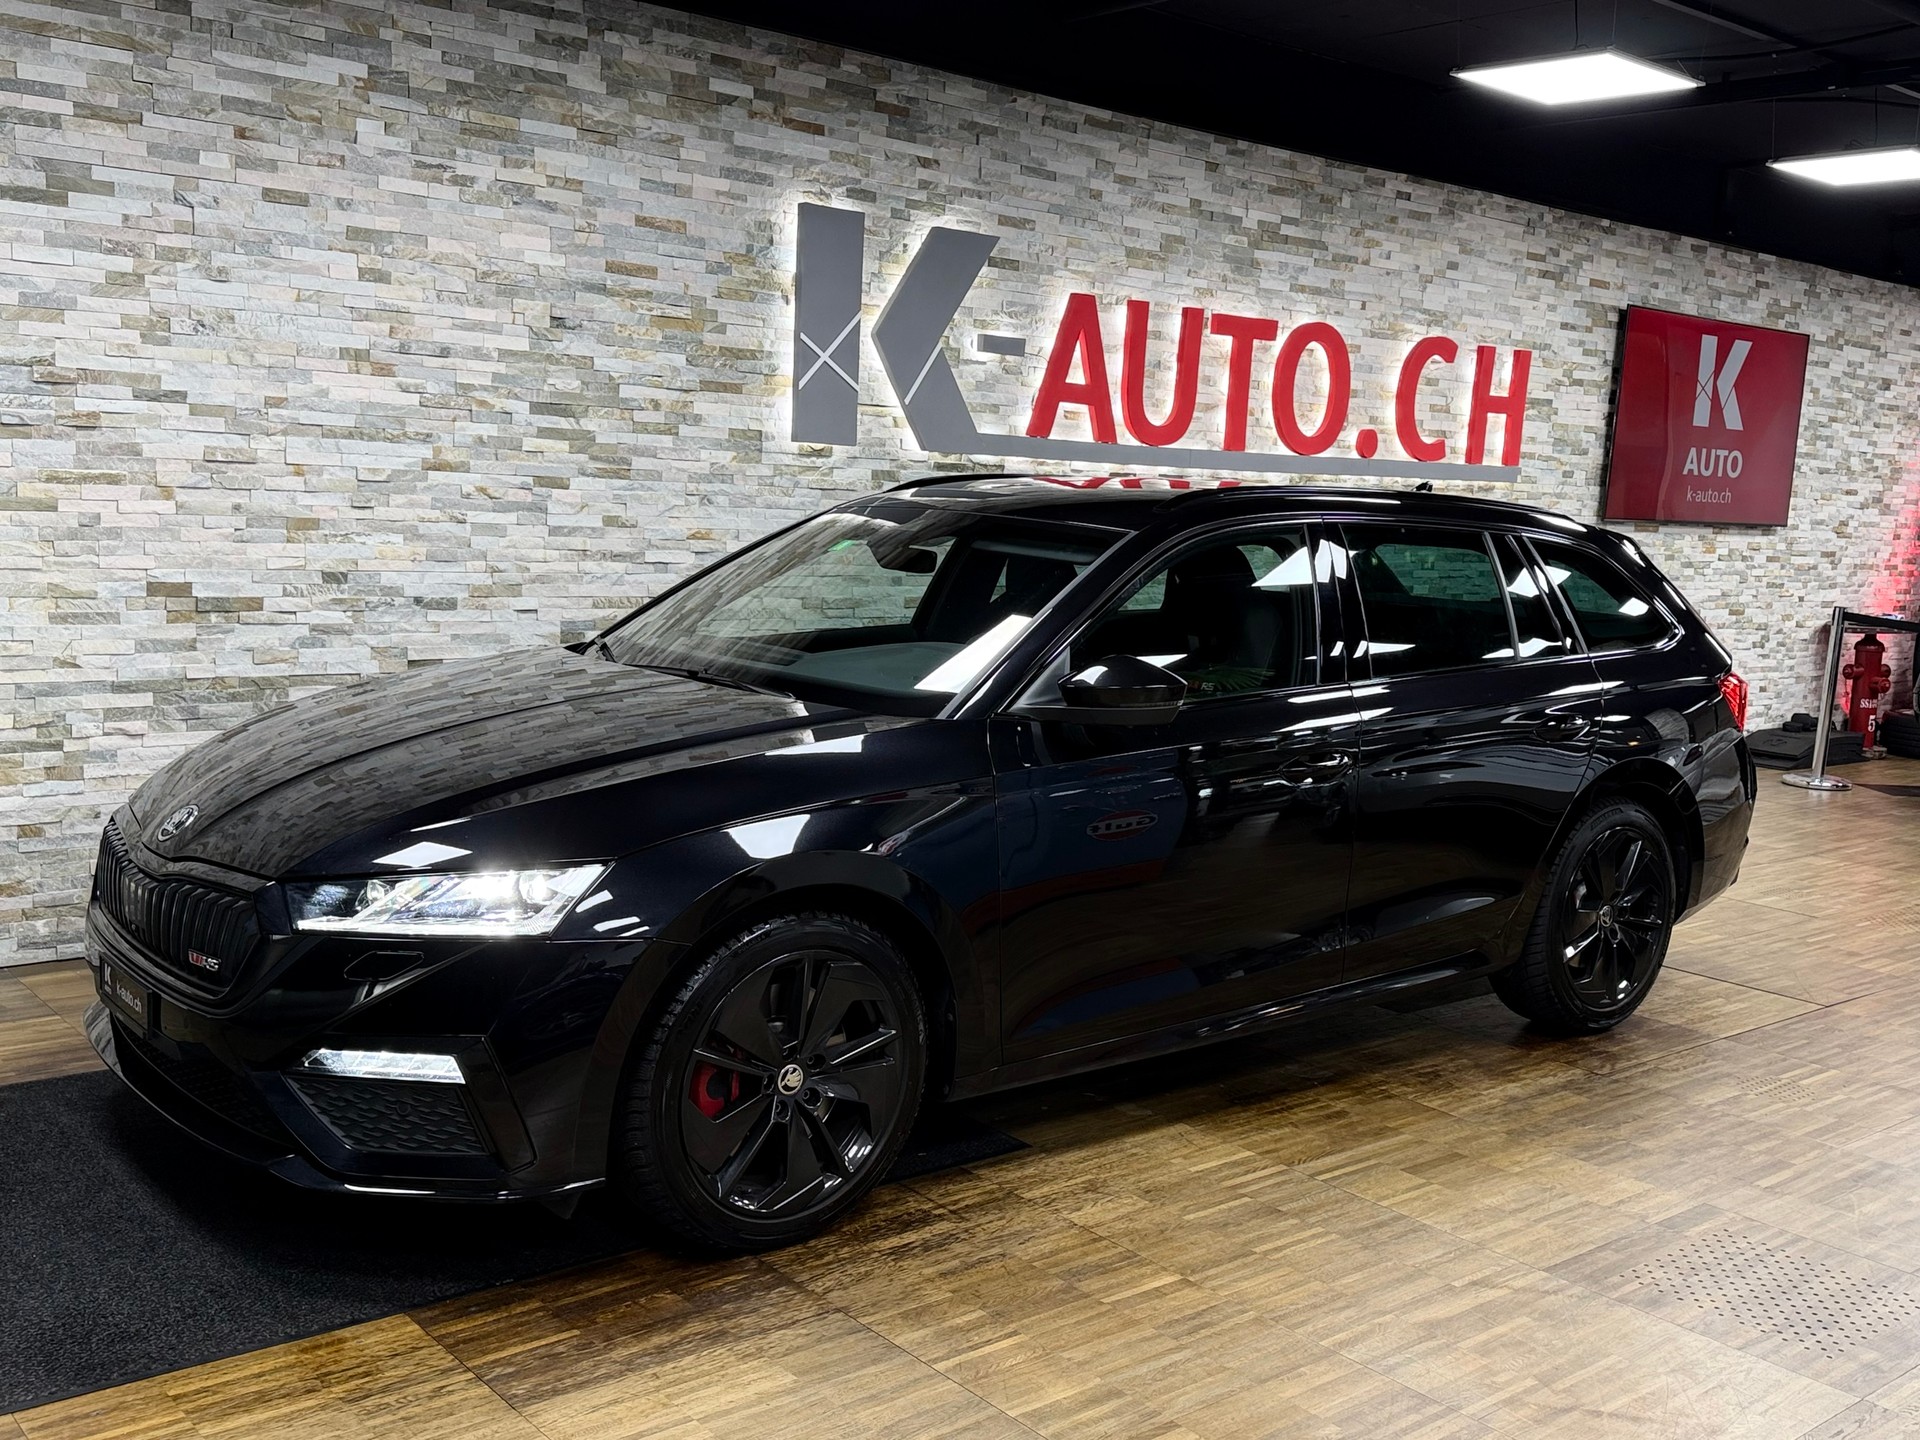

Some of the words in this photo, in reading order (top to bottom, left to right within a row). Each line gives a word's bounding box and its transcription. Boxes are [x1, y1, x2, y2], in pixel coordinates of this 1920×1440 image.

[1693, 333, 1753, 431] K
[1682, 447, 1743, 479] AUTO
[1686, 485, 1732, 504] k-auto.ch
[1867, 714, 1876, 733] 5
